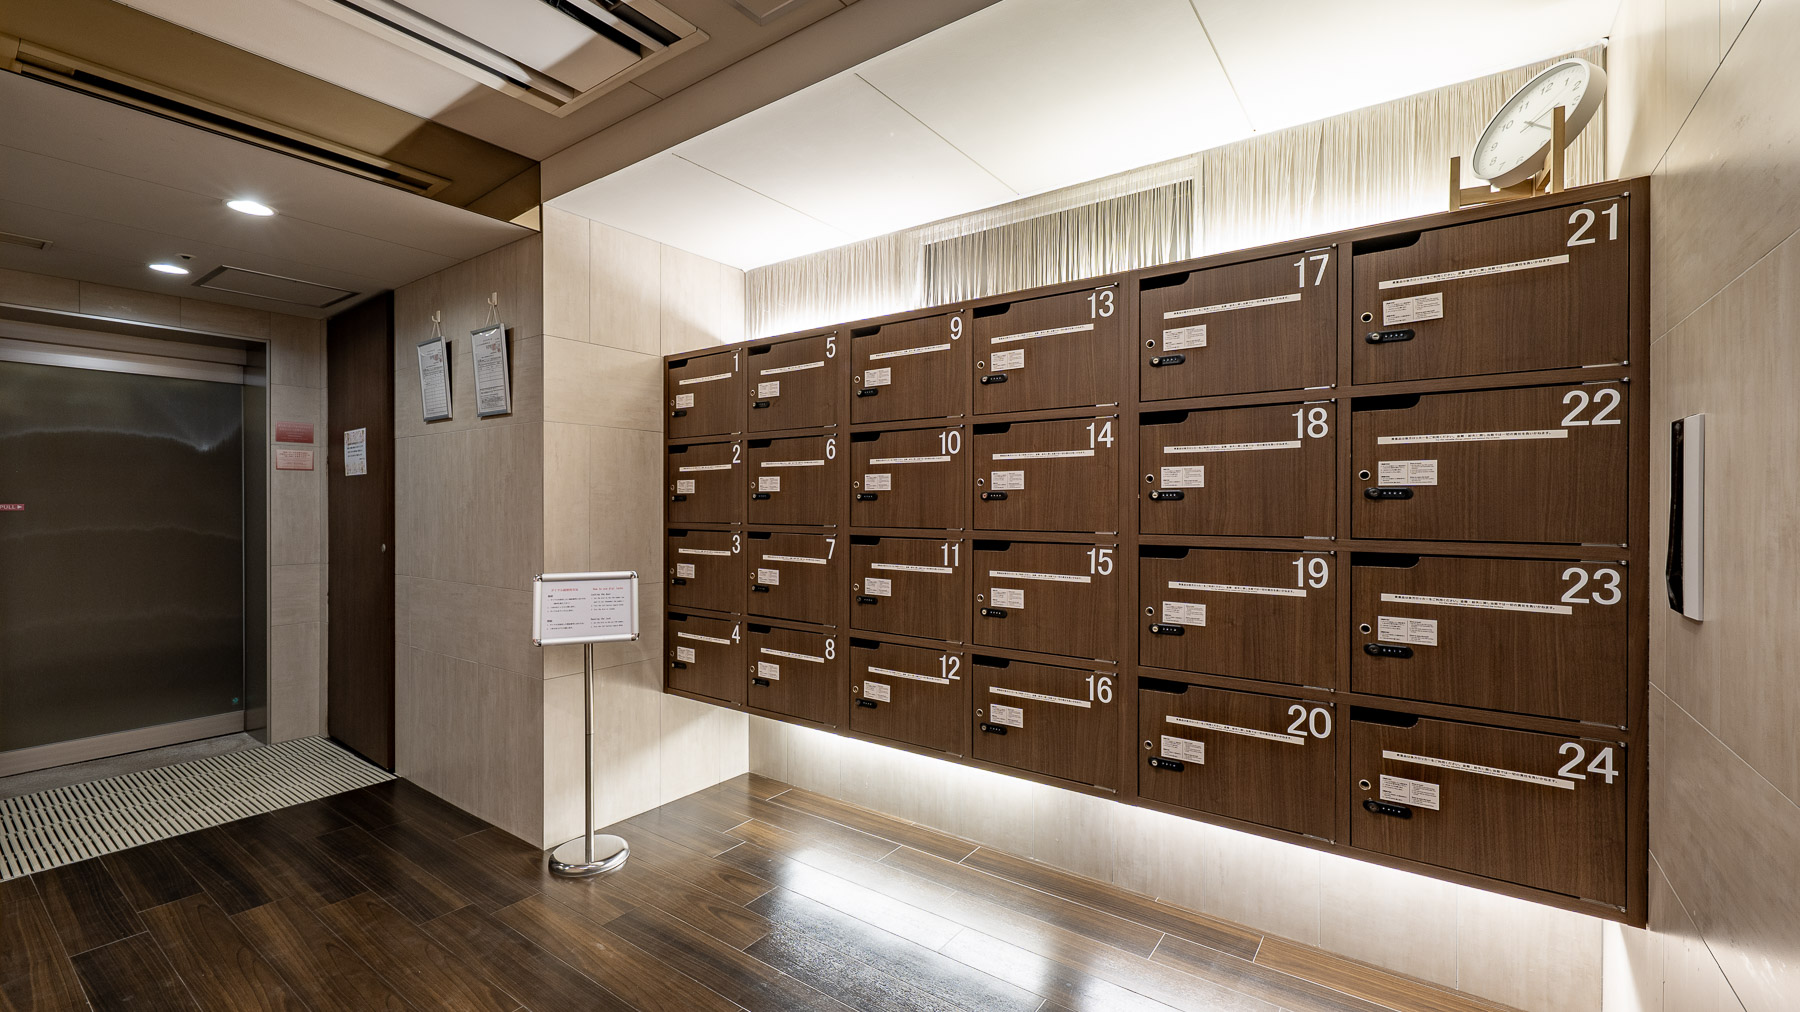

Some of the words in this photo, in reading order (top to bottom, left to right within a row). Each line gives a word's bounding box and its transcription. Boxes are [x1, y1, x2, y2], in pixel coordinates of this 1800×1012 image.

[1541, 82, 1554, 95] 12
[1572, 80, 1582, 91] 2
[1519, 101, 1530, 113] 11
[1502, 120, 1514, 132] 10
[1490, 142, 1498, 151] 9
[1489, 156, 1497, 166] 8
[1498, 161, 1506, 171] 7
[1567, 203, 1617, 246] 21
[1294, 254, 1329, 288] 17
[1088, 291, 1114, 318] 13
[951, 317, 962, 340] 9
[826, 337, 835, 358] 5
[733, 353, 739, 372] 1
[1561, 389, 1620, 426] 22
[1292, 408, 1328, 438] 18
[939, 431, 960, 454] 10
[1087, 422, 1114, 448] 14
[733, 445, 740, 463] 2
[826, 439, 835, 459] 6
[733, 535, 740, 553] 3
[826, 539, 835, 559] 7
[941, 543, 958, 566] 11
[1087, 548, 1113, 575] 15
[1293, 557, 1328, 588] 19
[1561, 568, 1621, 605] 23
[732, 625, 740, 643] 4
[826, 639, 835, 659] 8
[940, 655, 960, 679] 12
[1086, 675, 1112, 703] 16
[1288, 705, 1331, 738] 20
[1558, 743, 1618, 785] 24
